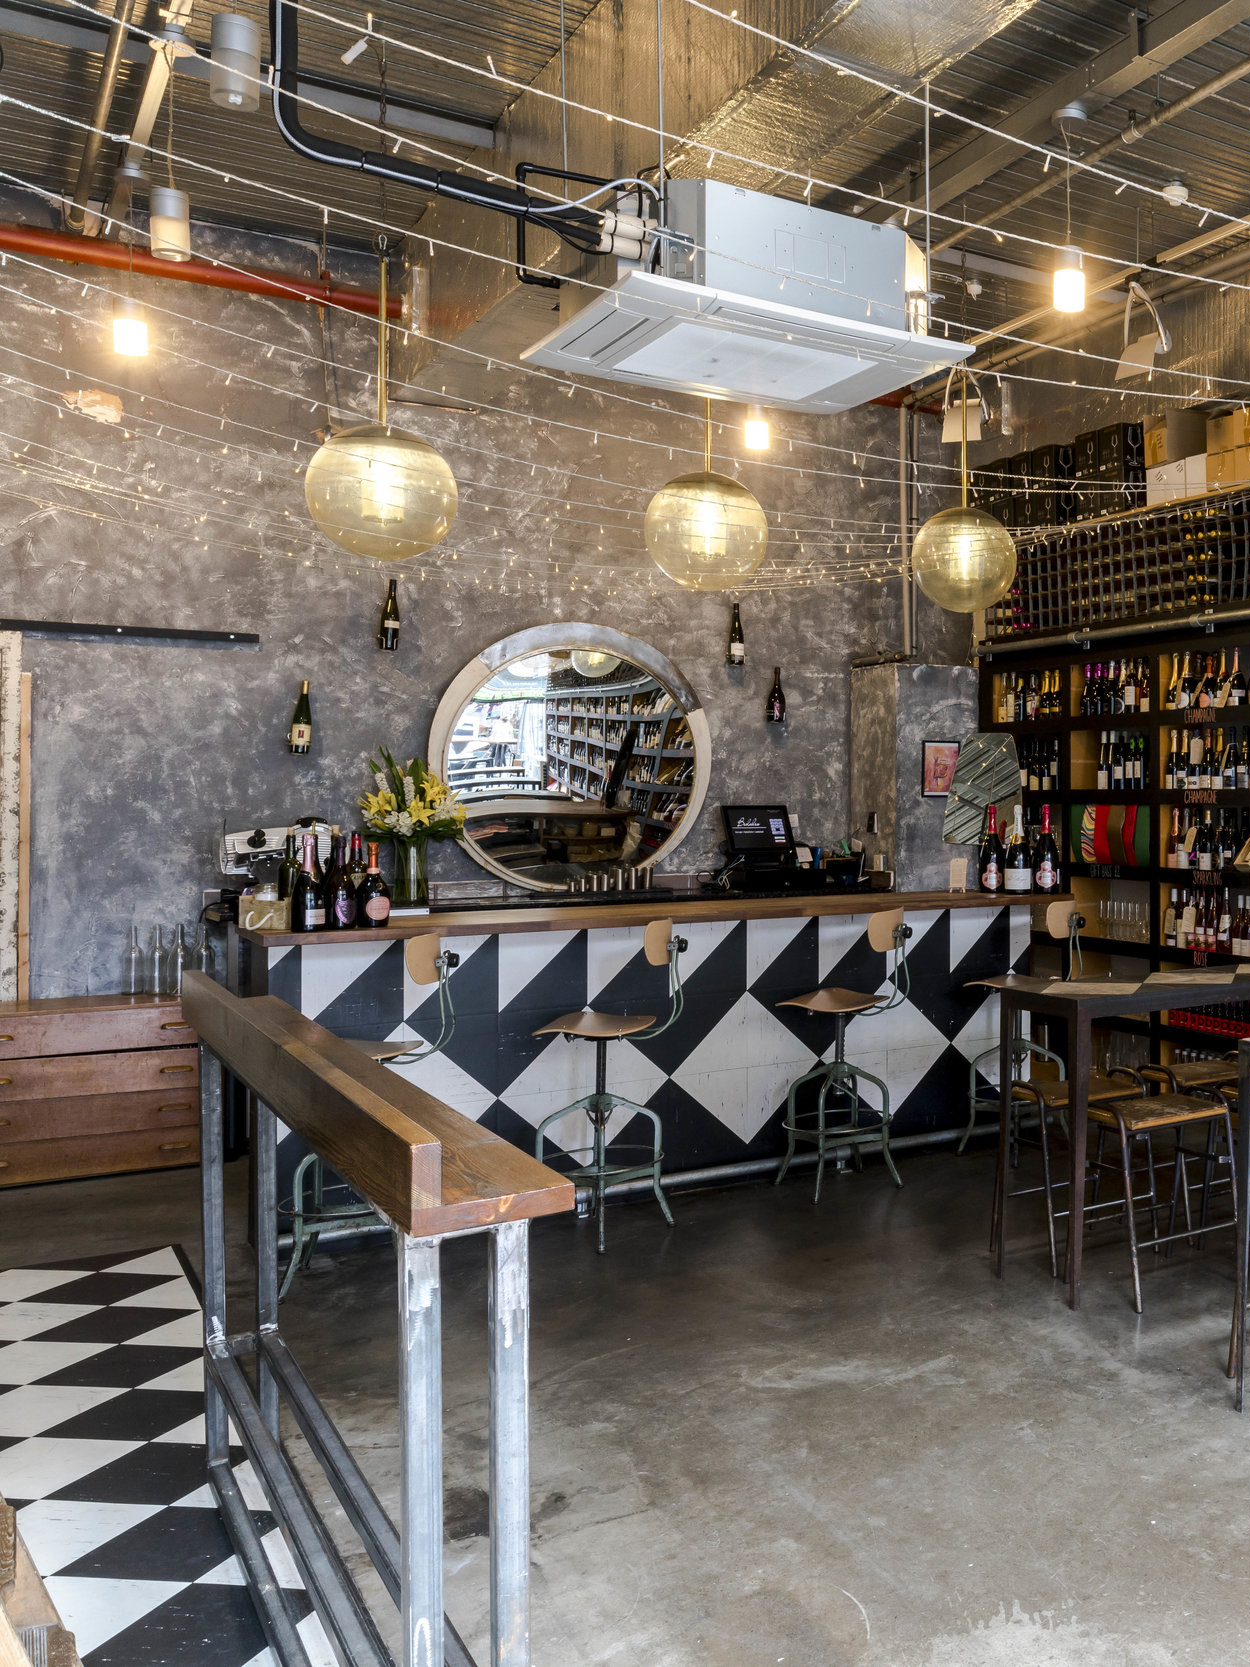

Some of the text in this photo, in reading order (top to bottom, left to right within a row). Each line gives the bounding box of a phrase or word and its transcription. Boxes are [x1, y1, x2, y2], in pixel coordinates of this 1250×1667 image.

[1184, 708, 1217, 724] CHAMPAGNE
[1184, 790, 1217, 805] CHAMPAGNE
[1192, 871, 1223, 886] SPARKLING
